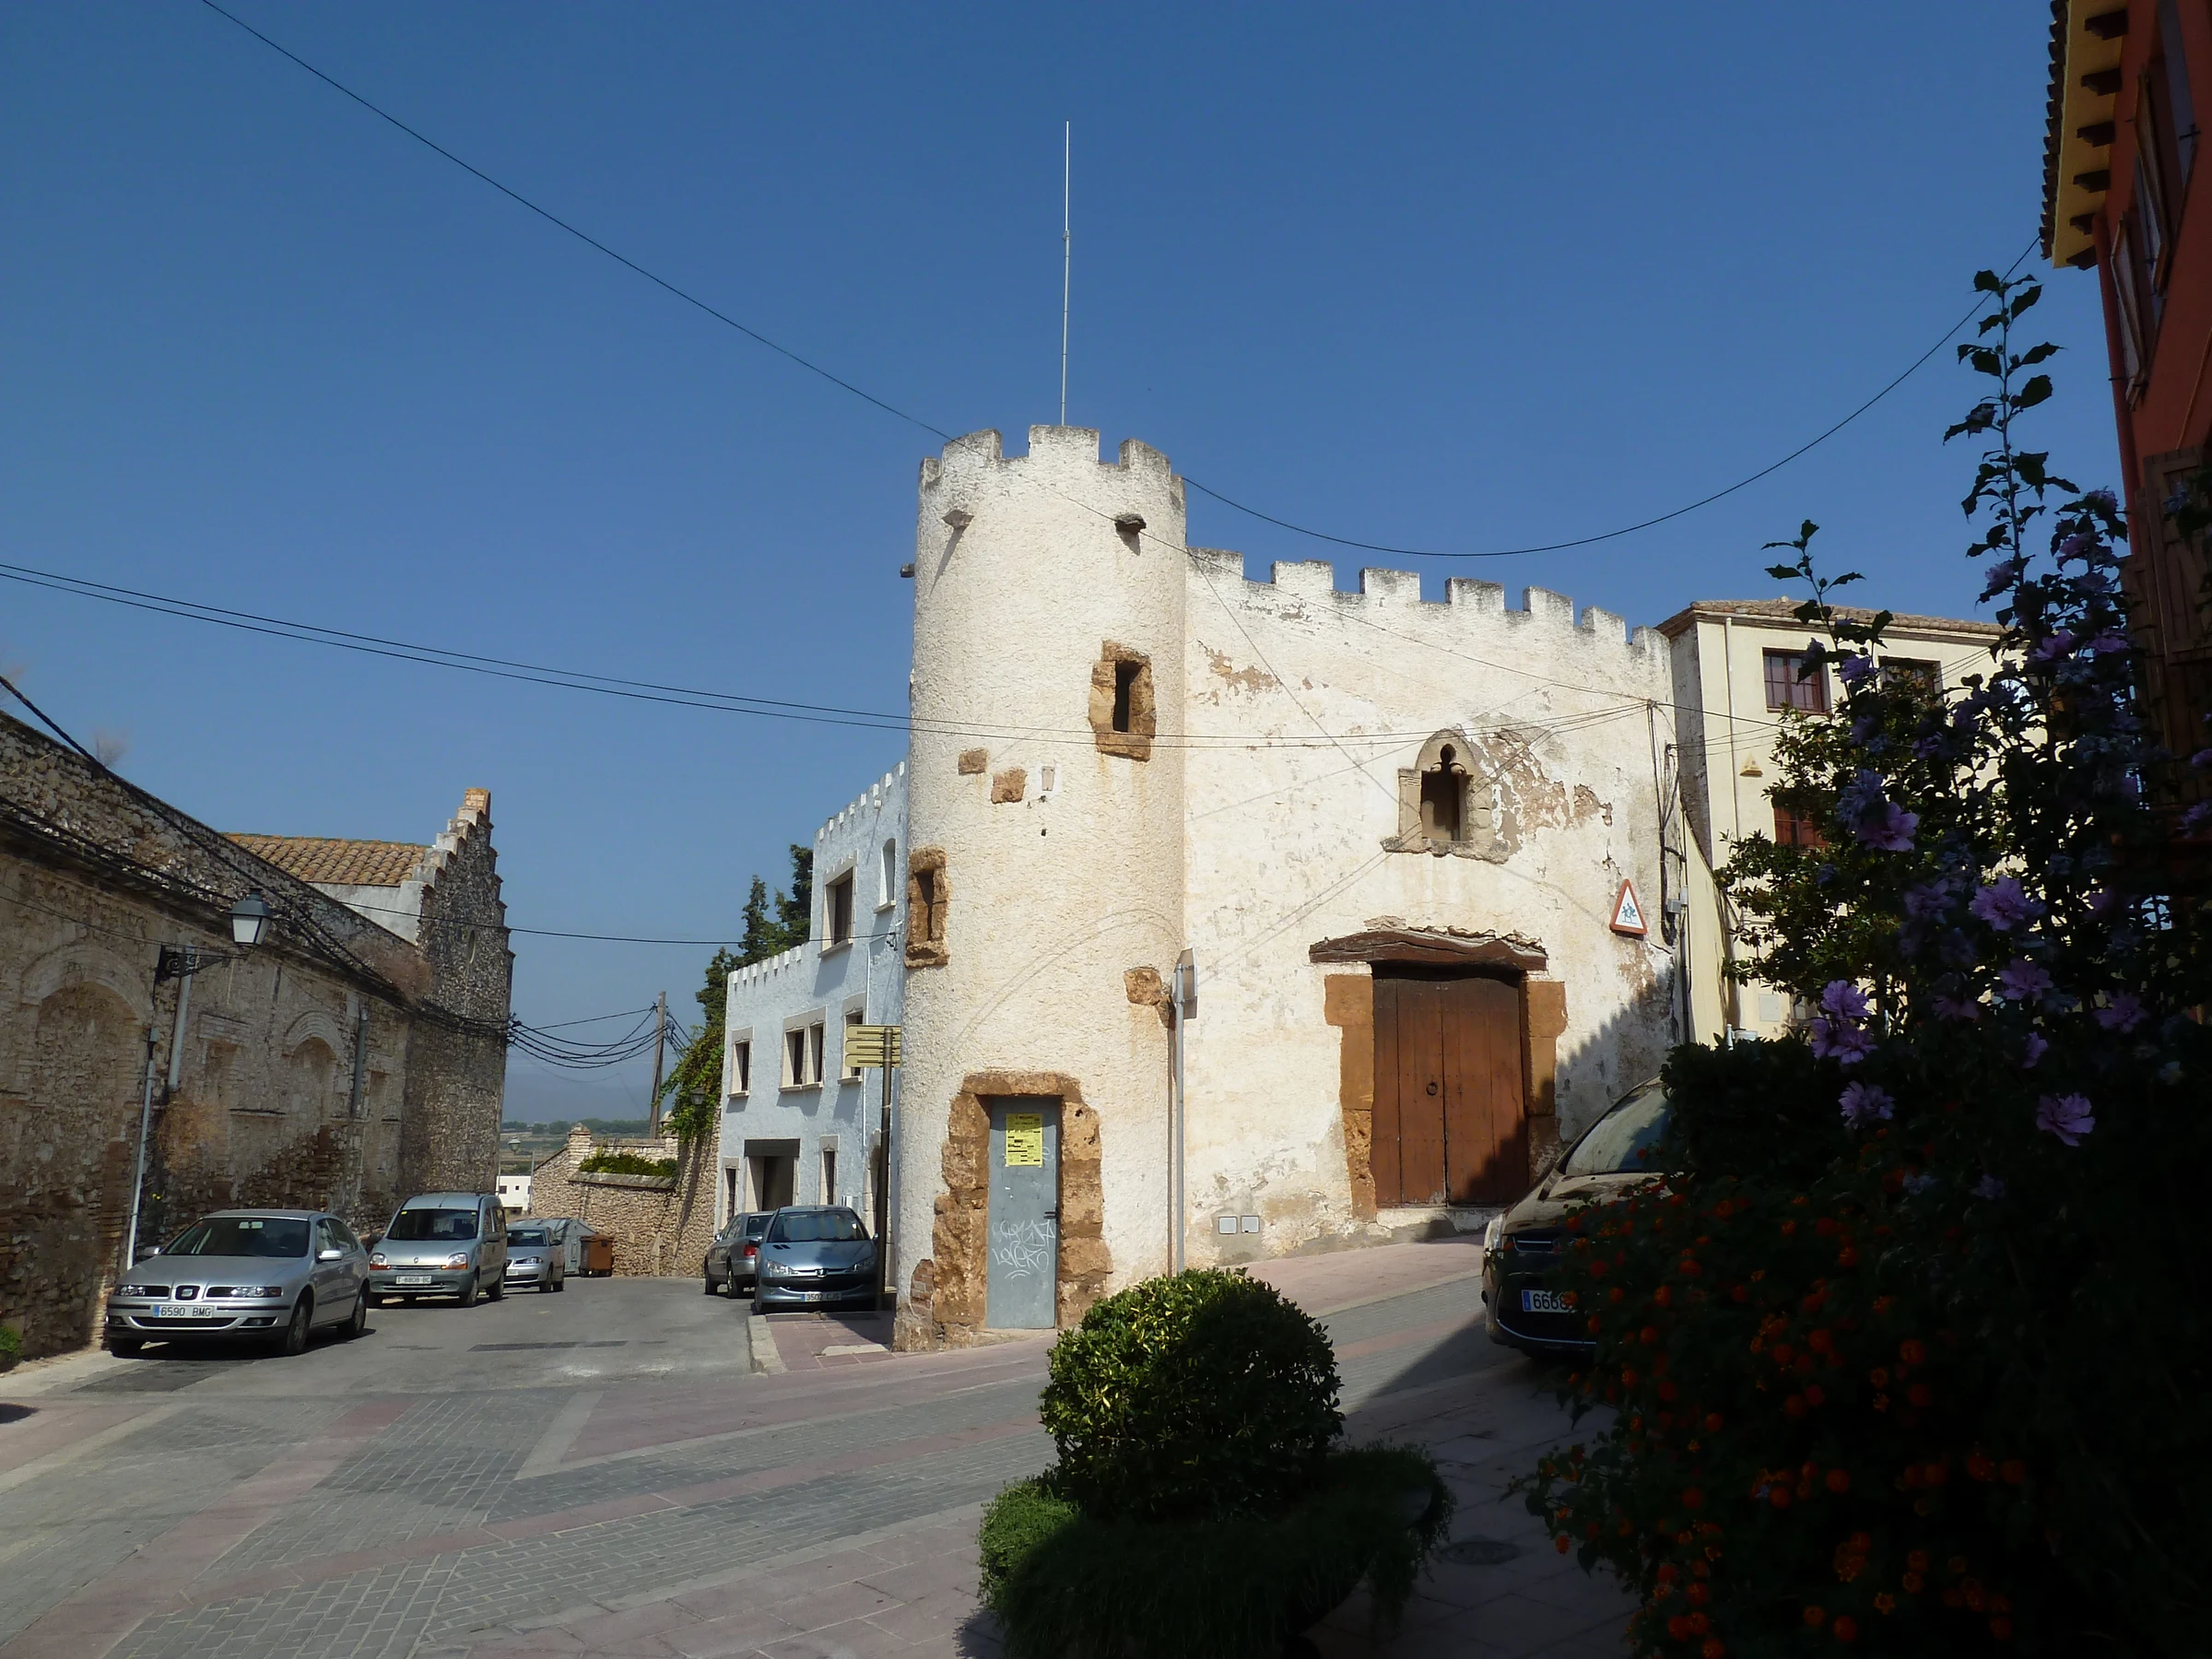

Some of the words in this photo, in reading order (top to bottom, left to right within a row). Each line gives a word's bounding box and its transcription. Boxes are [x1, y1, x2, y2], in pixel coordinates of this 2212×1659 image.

[806, 1293, 823, 1301] 3502
[160, 1306, 185, 1317] 6590
[192, 1307, 211, 1317] BMG
